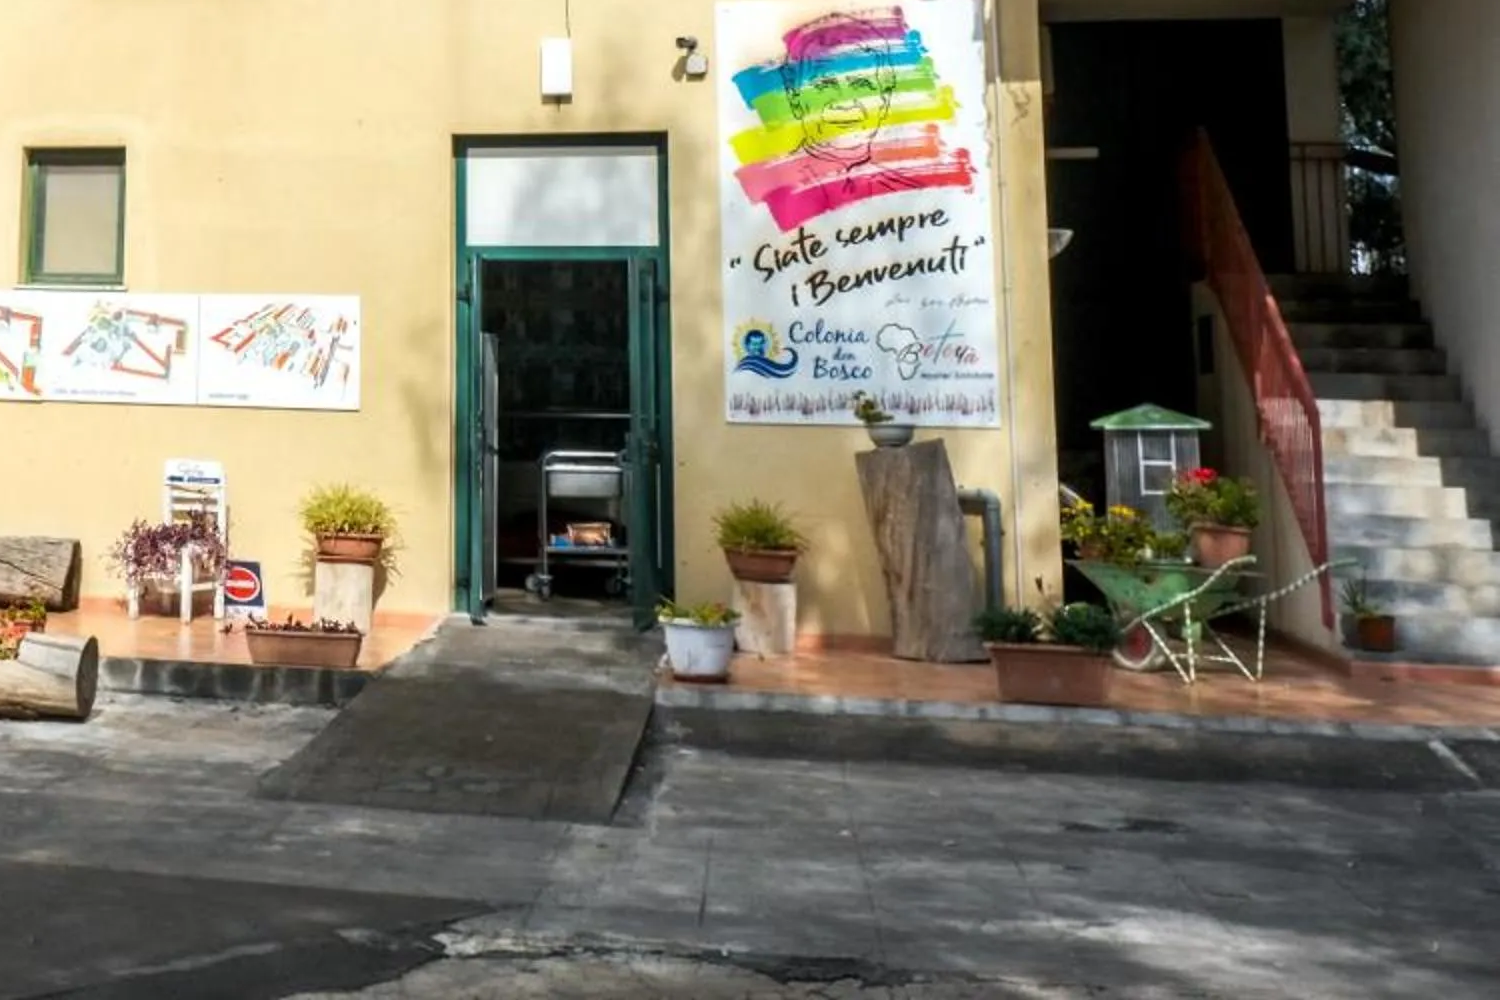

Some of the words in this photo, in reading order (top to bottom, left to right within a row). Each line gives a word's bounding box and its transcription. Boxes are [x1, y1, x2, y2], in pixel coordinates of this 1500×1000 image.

[836, 208, 950, 248] sempre
[788, 318, 871, 345] Colonia
[832, 346, 855, 361] don
[813, 356, 873, 380] Bosco
